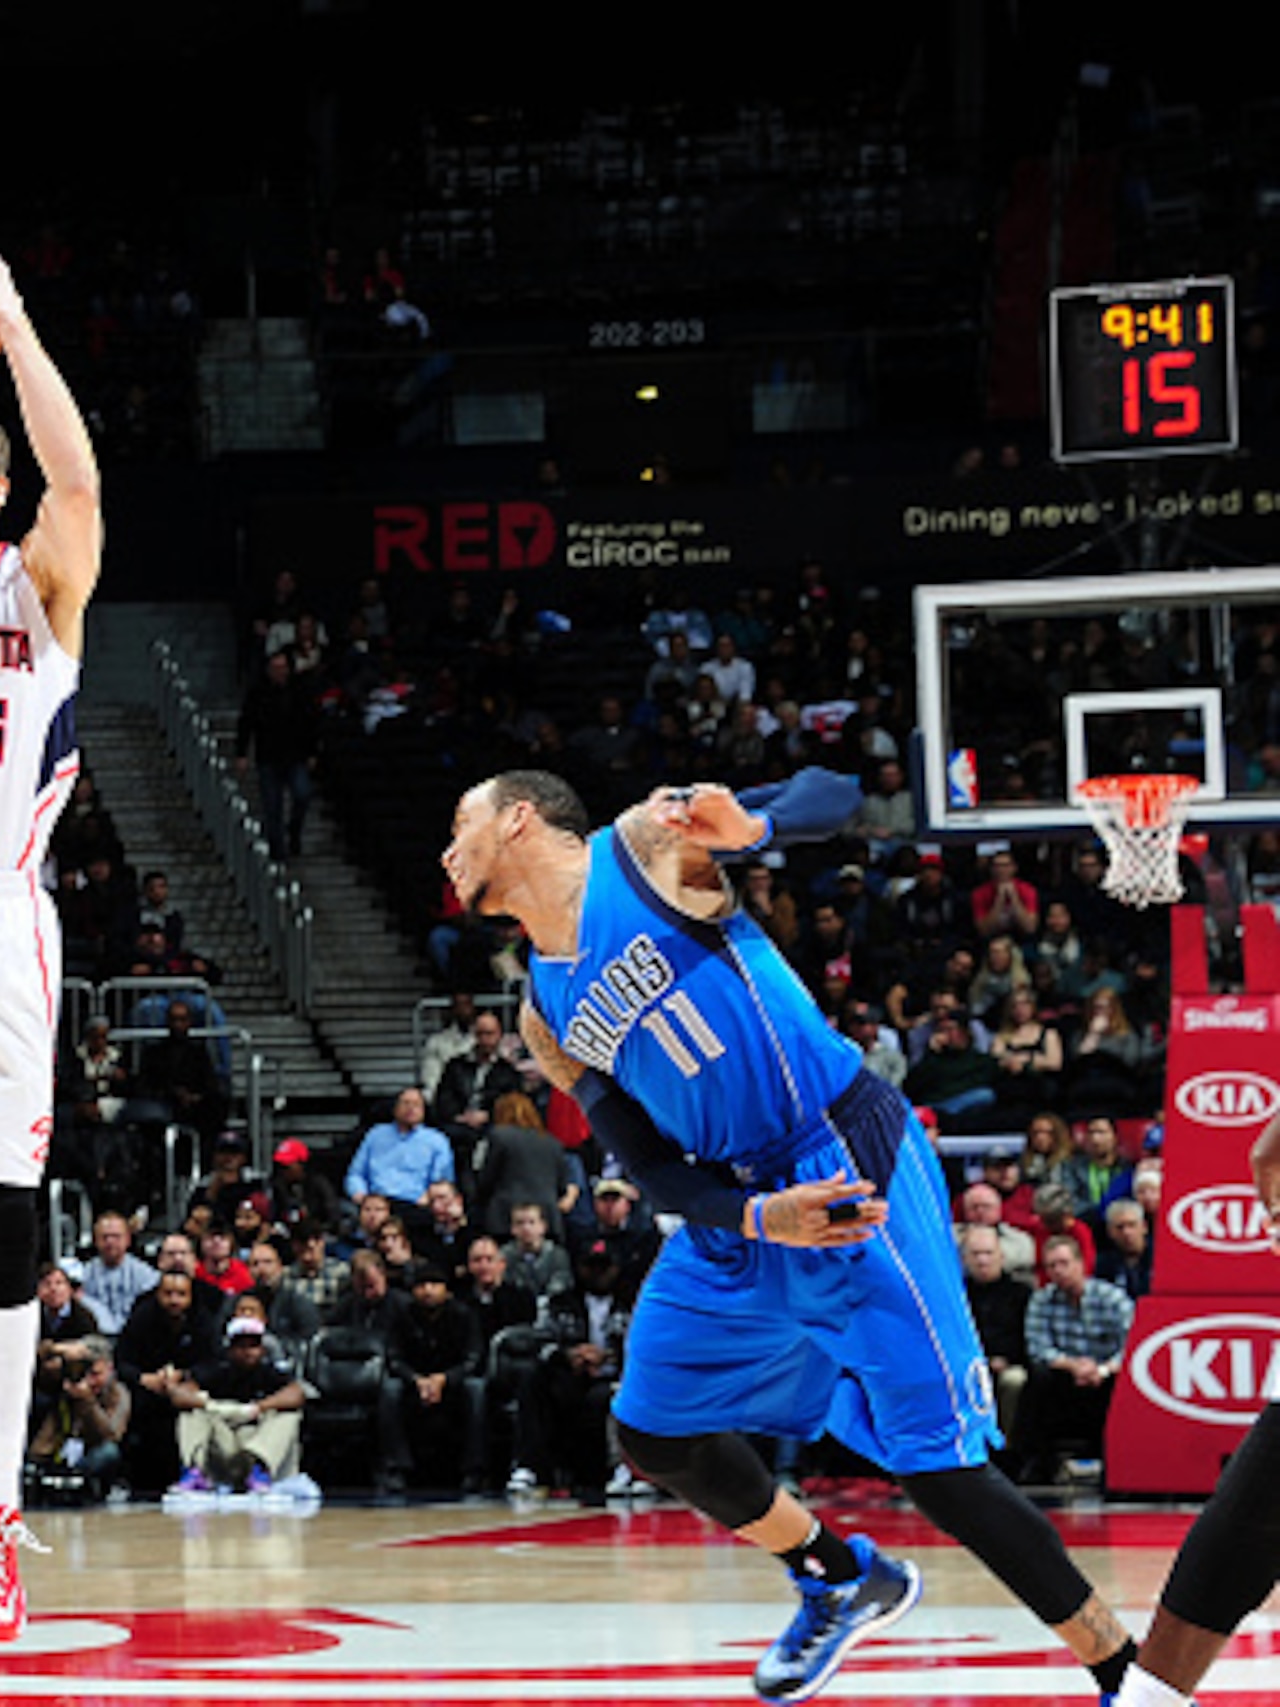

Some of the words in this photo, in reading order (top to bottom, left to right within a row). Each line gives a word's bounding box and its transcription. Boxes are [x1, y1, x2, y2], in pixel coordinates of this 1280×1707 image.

[587, 318, 705, 348] 202-203
[1101, 301, 1214, 350] 9:41
[1122, 350, 1201, 437] 15
[373, 501, 556, 570] RED
[904, 505, 1010, 537] Dining
[639, 988, 726, 1080] 11
[1195, 1082, 1266, 1115] KIA
